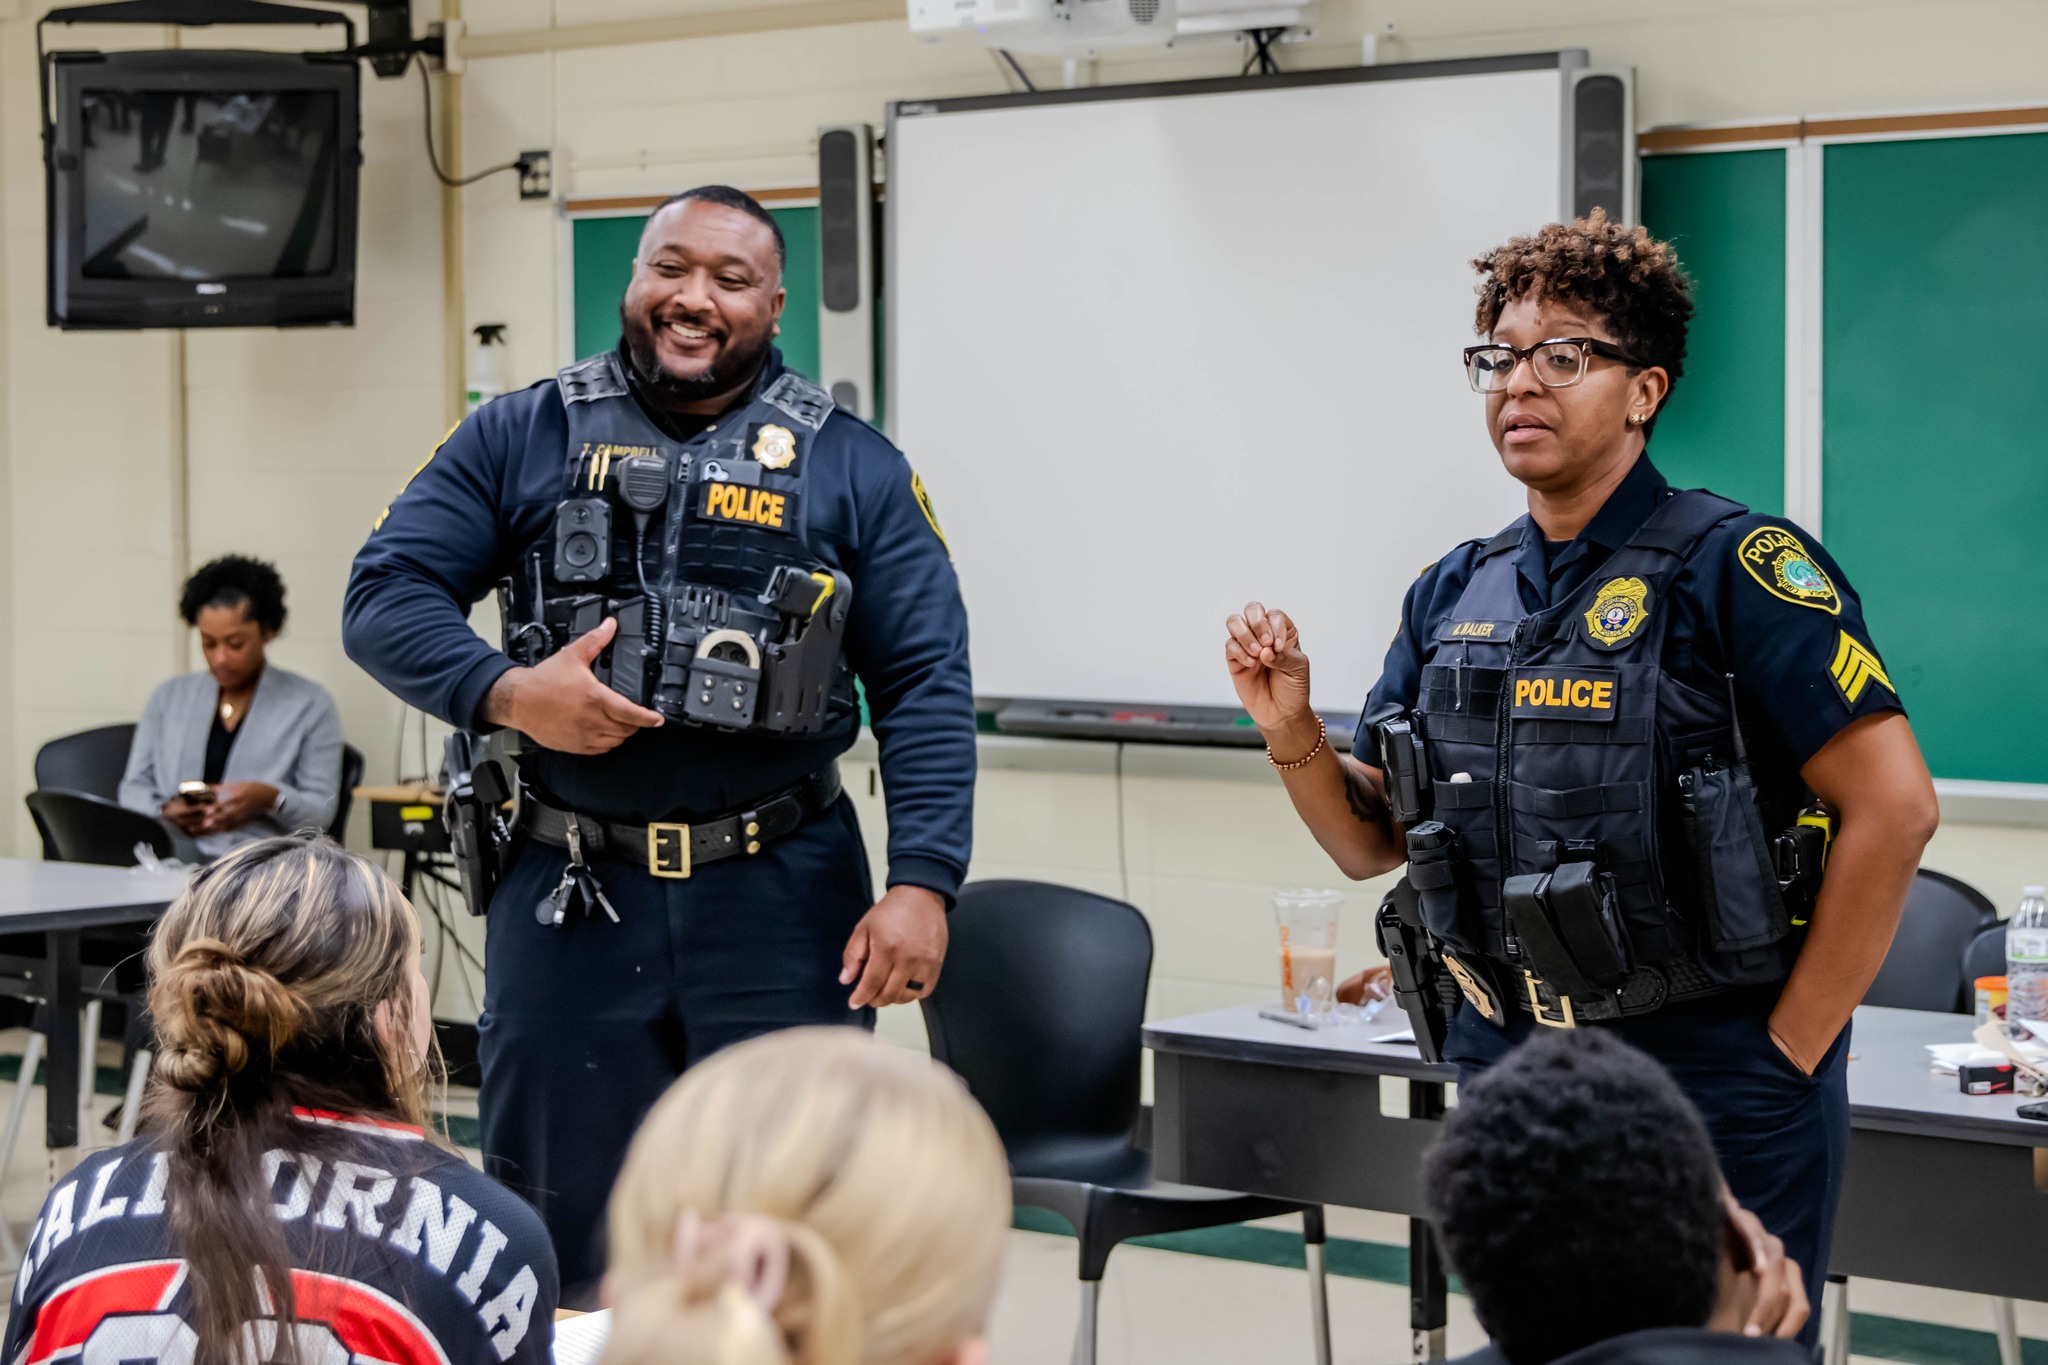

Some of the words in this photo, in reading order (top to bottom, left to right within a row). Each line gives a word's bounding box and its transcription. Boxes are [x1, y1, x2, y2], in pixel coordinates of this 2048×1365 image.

[706, 483, 785, 528] POLICE
[1460, 622, 1495, 638] WALKER
[1515, 679, 1613, 709] POLICE
[19, 1149, 538, 1361] CALIORNIA
